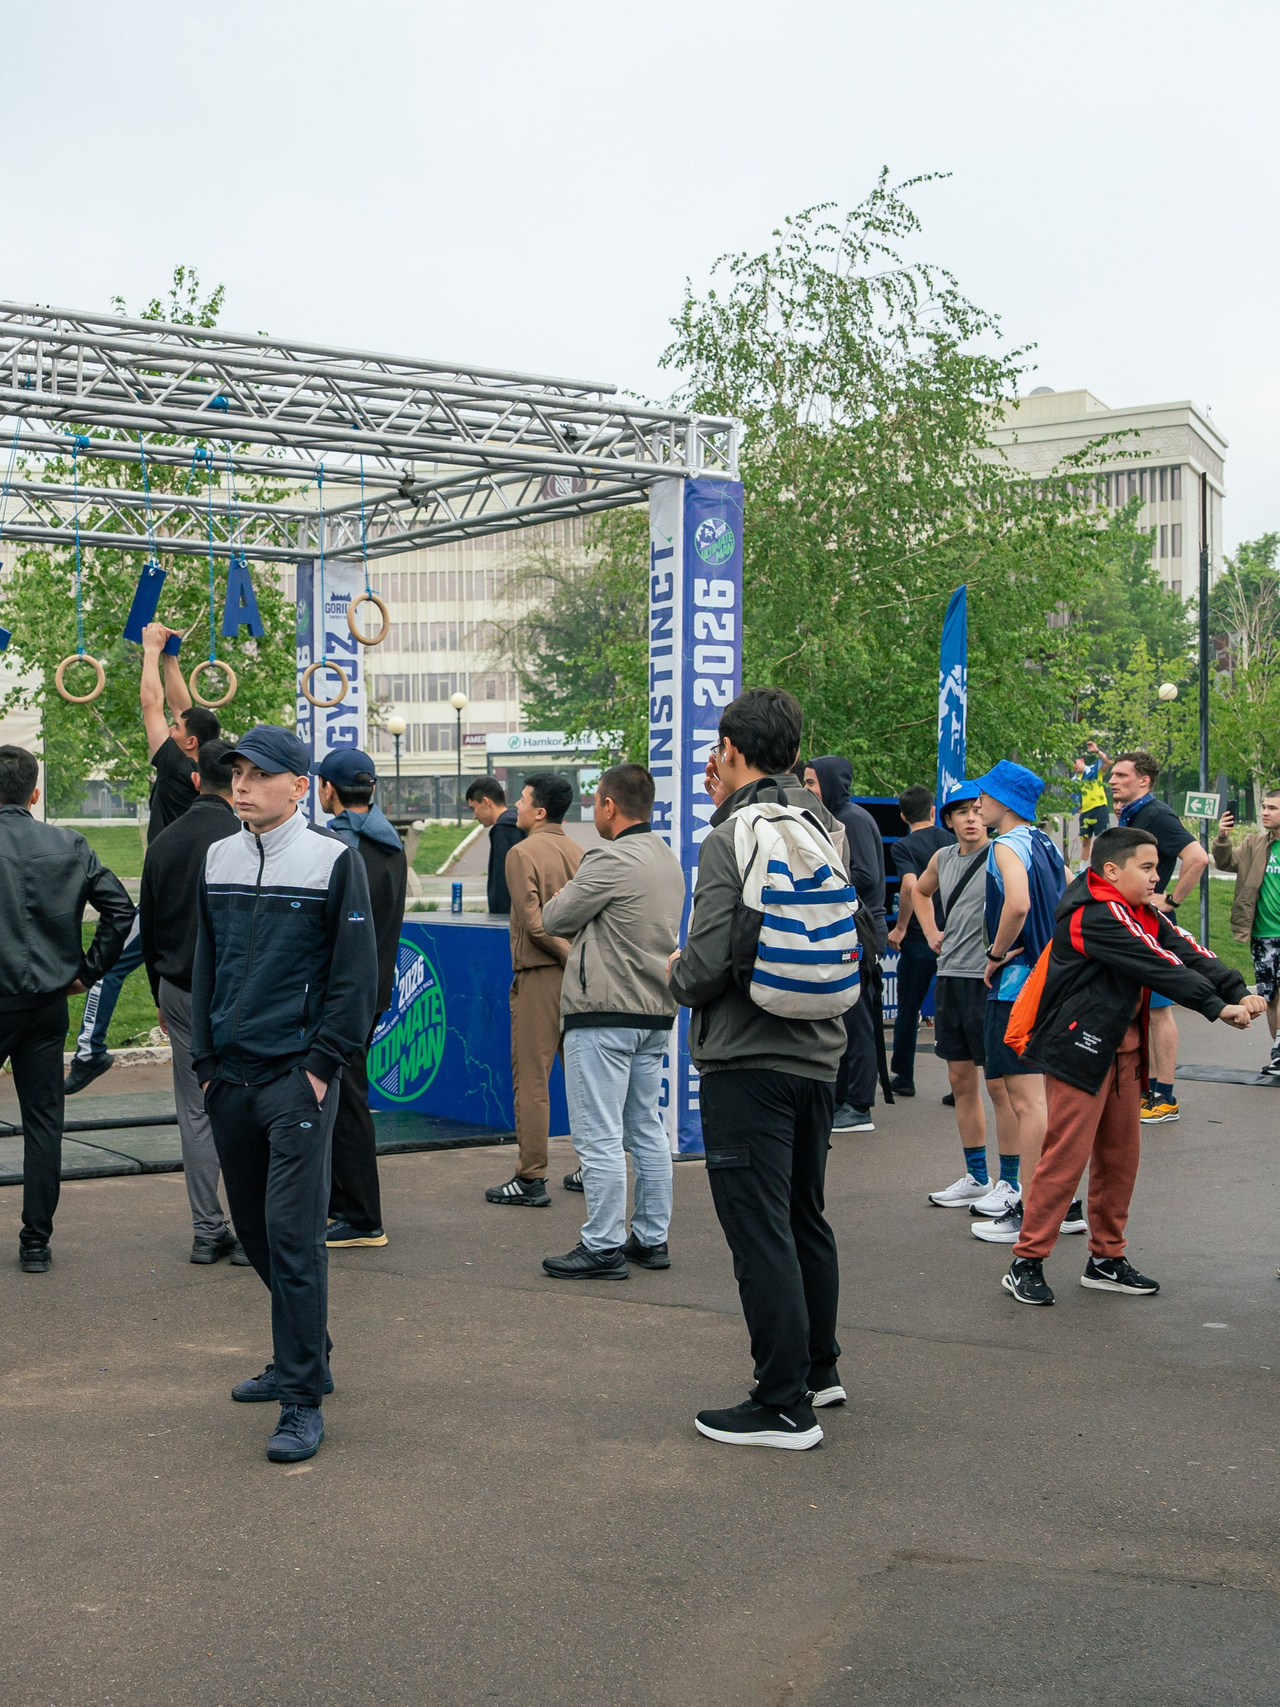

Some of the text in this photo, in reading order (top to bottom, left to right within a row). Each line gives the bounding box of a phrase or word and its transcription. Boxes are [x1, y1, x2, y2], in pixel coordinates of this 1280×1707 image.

[650, 541, 674, 777] INSTINCT
[693, 578, 734, 707] 2026
[398, 954, 424, 1010] 2026
[368, 989, 442, 1081] ULTIMATE
[399, 1025, 441, 1096] MAN
